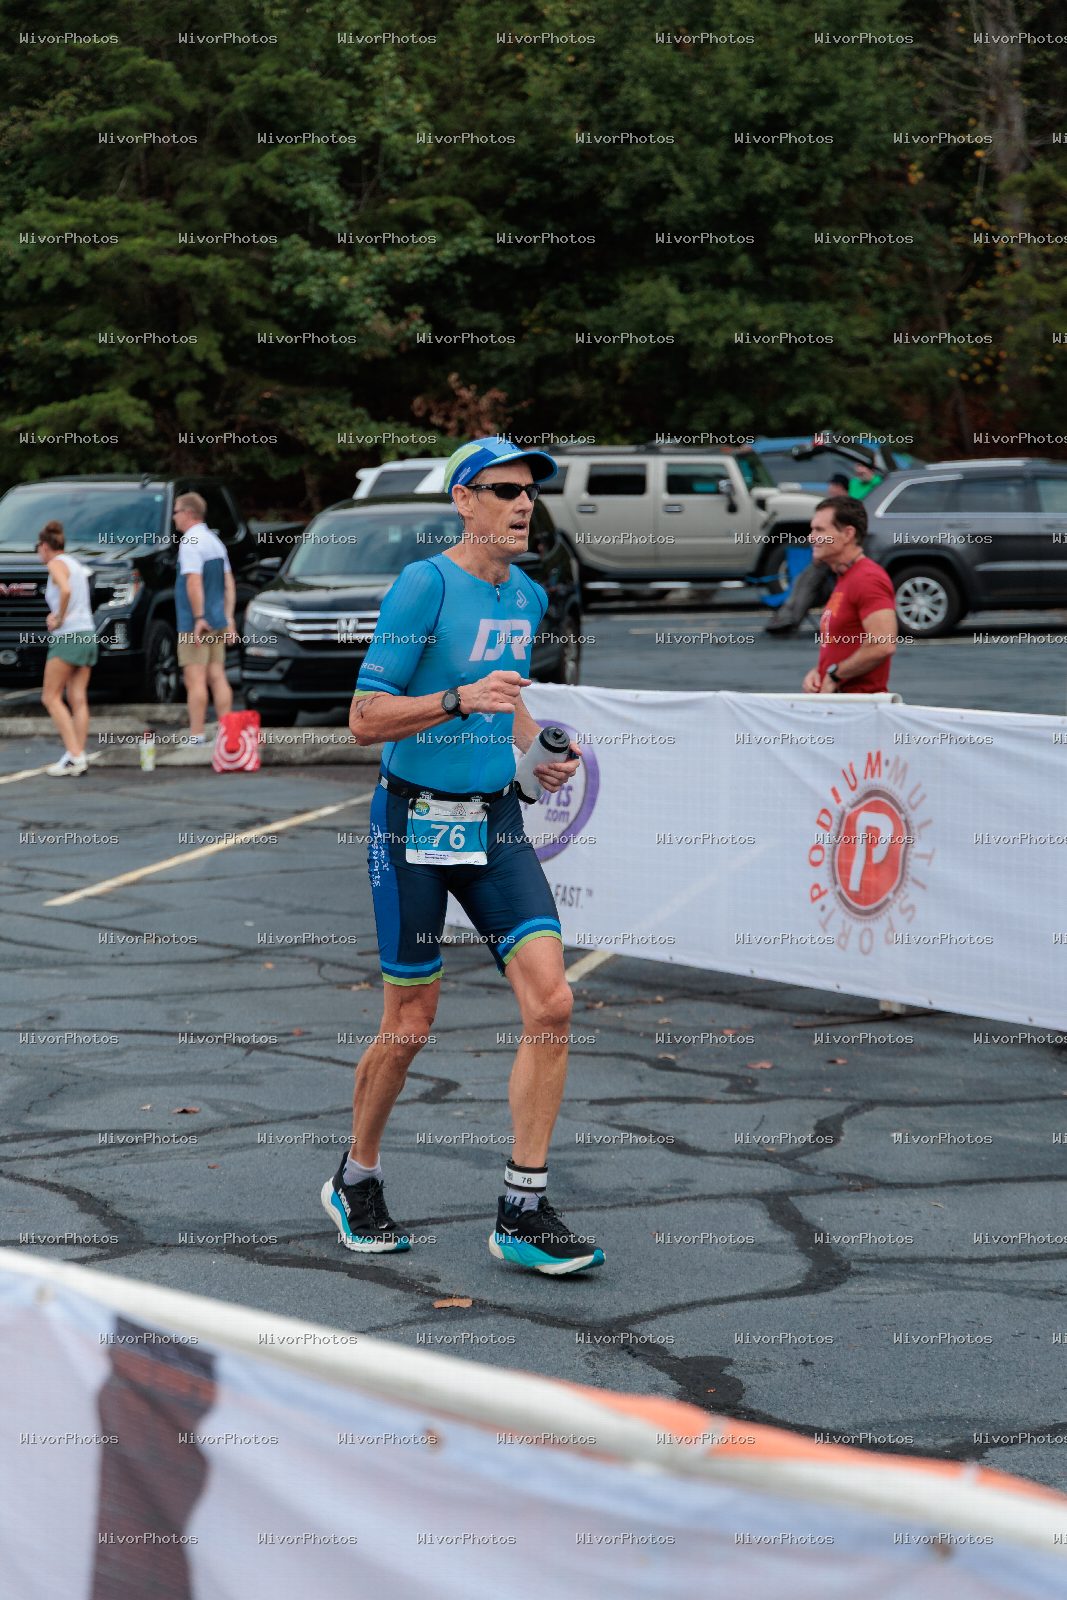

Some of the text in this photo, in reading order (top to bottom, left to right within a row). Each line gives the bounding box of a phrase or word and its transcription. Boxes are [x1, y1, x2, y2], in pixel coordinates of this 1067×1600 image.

[430, 823, 467, 850] 76
[808, 750, 882, 904] PODIUM
[848, 810, 895, 892] P
